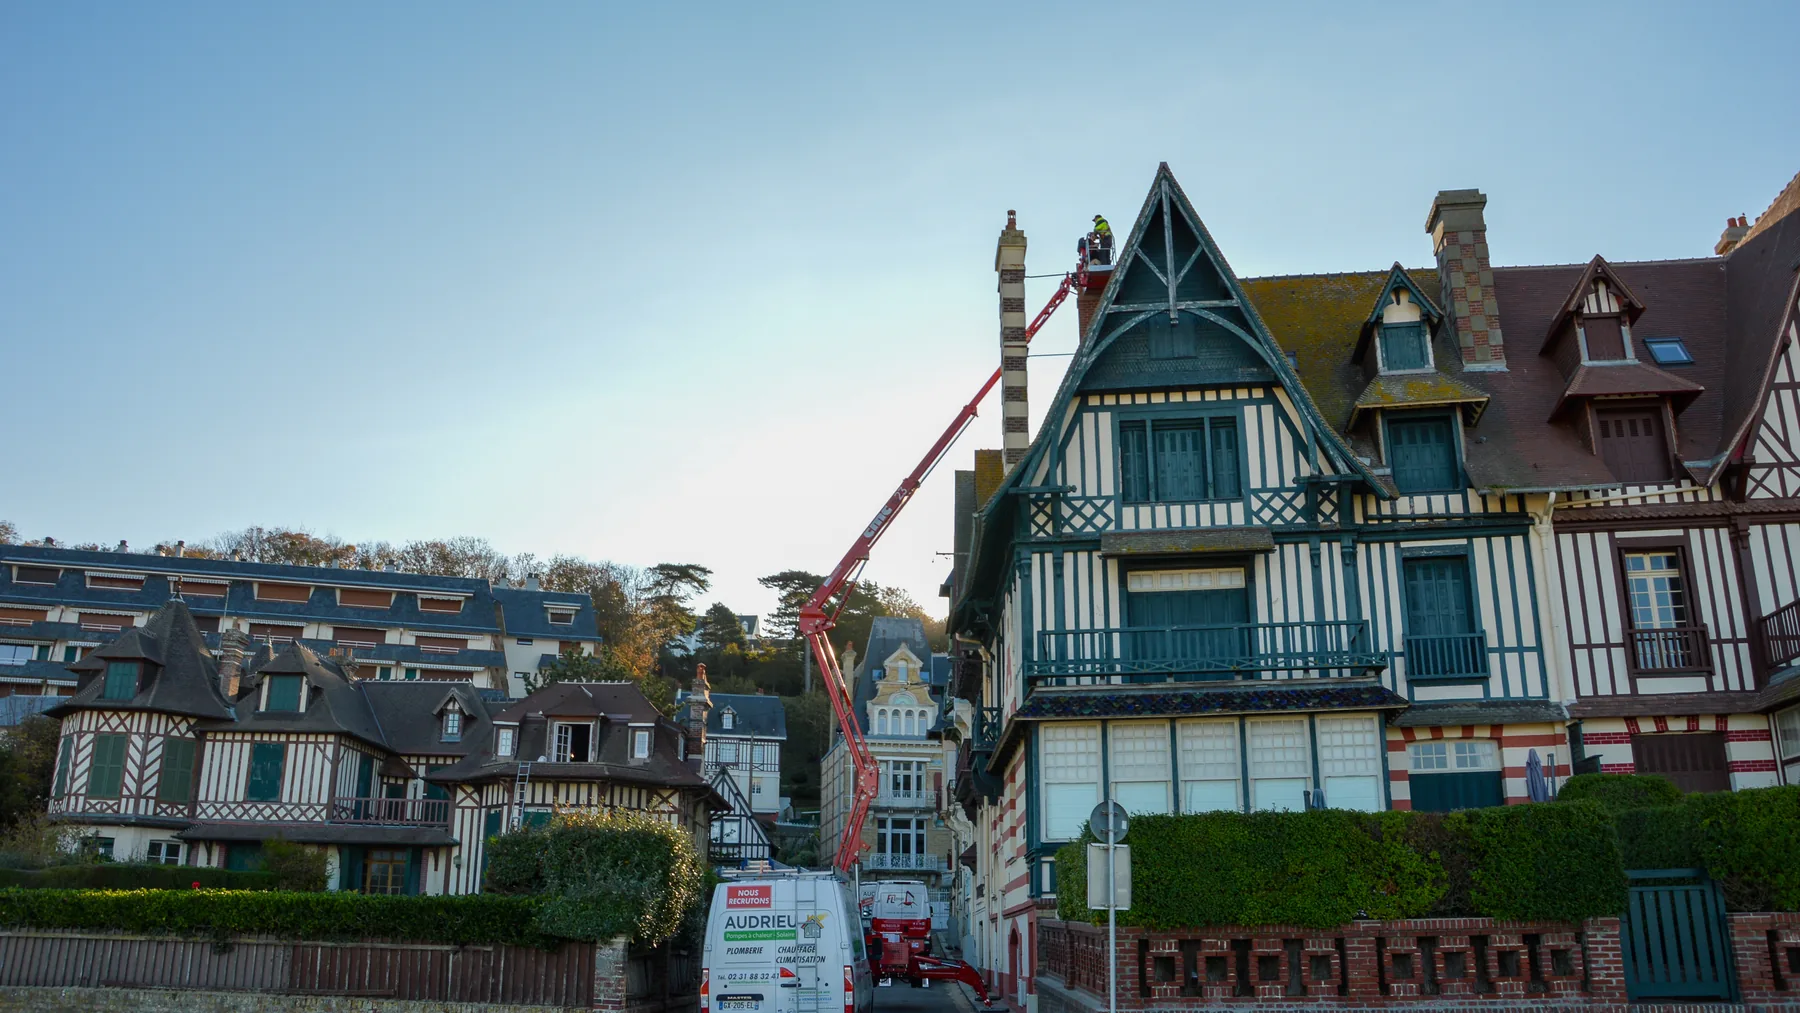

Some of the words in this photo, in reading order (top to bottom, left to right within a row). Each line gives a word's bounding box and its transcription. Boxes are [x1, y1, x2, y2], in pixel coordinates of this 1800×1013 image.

[738, 889, 759, 897] NOUS
[728, 897, 770, 905] RECRUTONS
[725, 914, 797, 930] AUDRIEU
[726, 931, 746, 940] Pompes
[776, 930, 795, 938] Solaire
[726, 946, 763, 955] PLOMBERIE
[775, 955, 826, 964] CLIMATISATION
[727, 973, 738, 981] 02
[771, 972, 780, 980] 41
[723, 1001, 754, 1010] GX-205-EL
